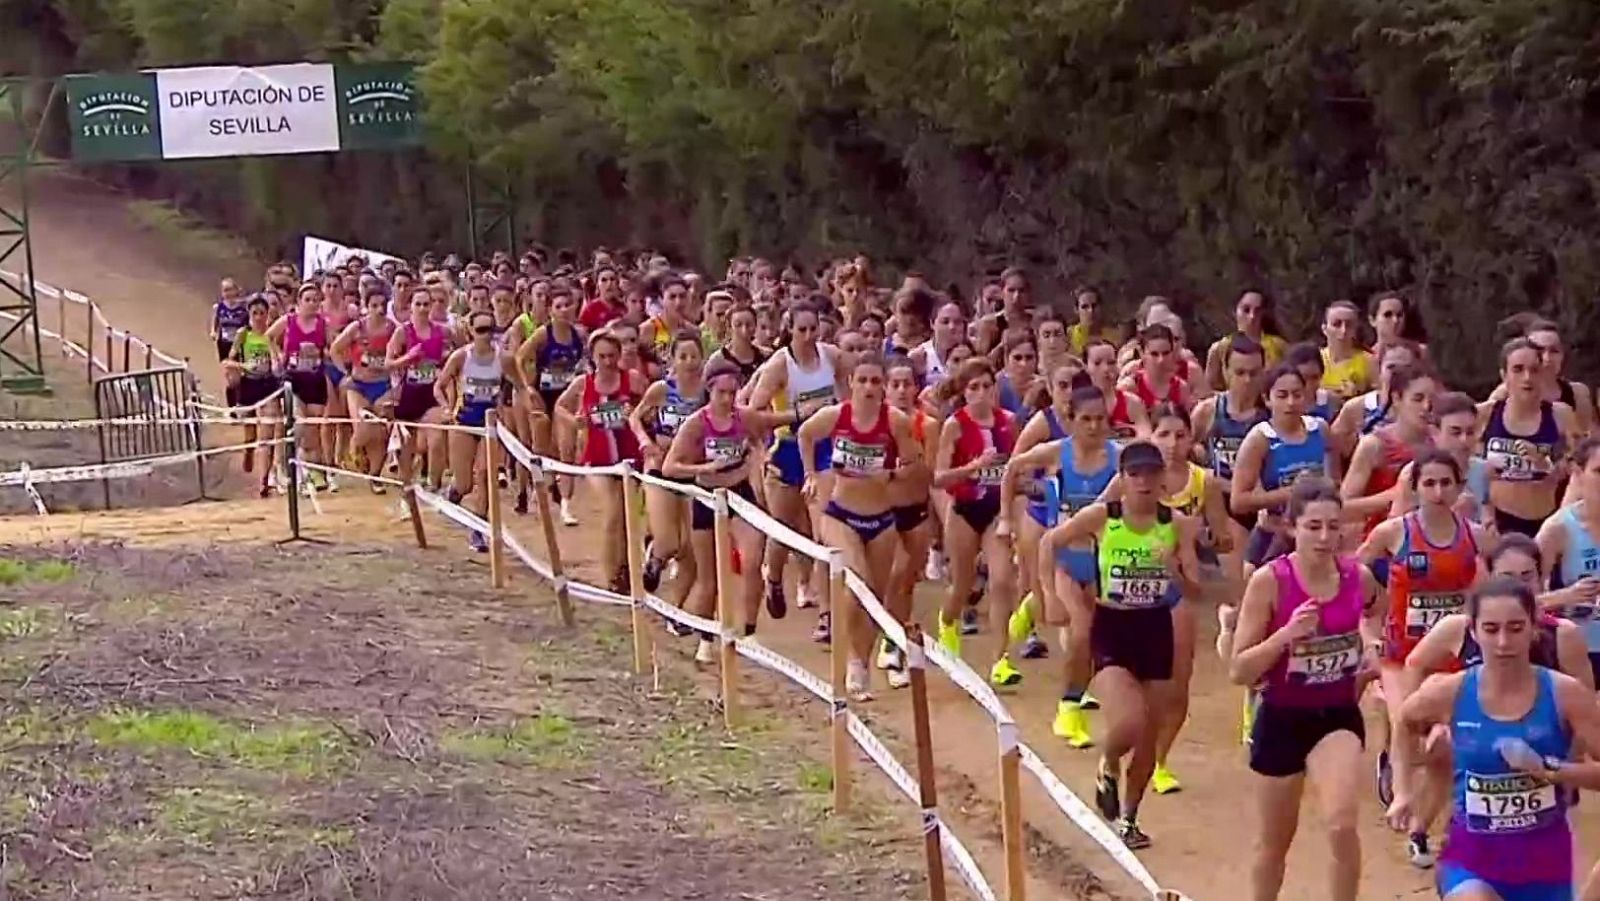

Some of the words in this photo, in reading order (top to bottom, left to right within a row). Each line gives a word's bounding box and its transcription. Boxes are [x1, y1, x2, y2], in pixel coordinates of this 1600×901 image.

[169, 85, 292, 109] DIPUTACIÓN
[298, 86, 325, 103] DE
[209, 116, 292, 135] SEVILLA
[349, 111, 413, 125] SEVILLA
[83, 123, 151, 137] SEVILLA
[1122, 580, 1162, 598] 1663
[1306, 651, 1350, 673] 1577
[1480, 792, 1542, 815] 1796
